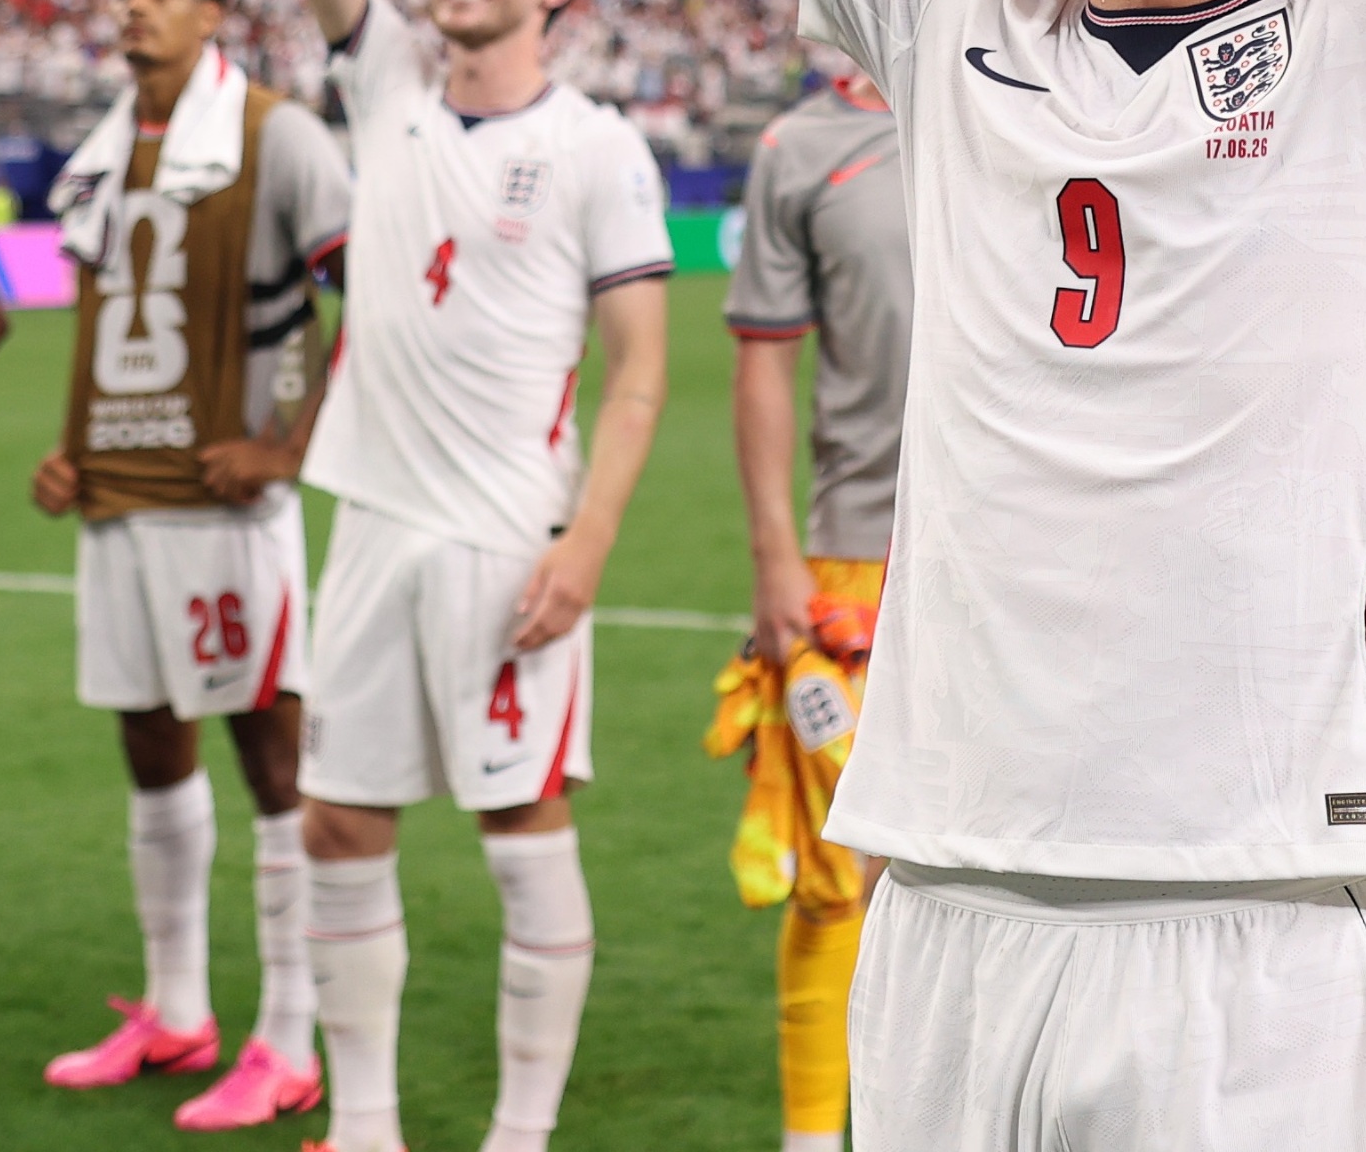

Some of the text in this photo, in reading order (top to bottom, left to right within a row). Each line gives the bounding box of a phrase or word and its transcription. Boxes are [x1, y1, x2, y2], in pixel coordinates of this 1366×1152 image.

[1206, 137, 1267, 159] 17.06.26
[1214, 110, 1275, 132] OATIA
[425, 238, 457, 306] 4
[1051, 178, 1125, 350] 9
[89, 417, 194, 451] 2026
[189, 592, 249, 665] 26
[487, 662, 524, 741] 4
